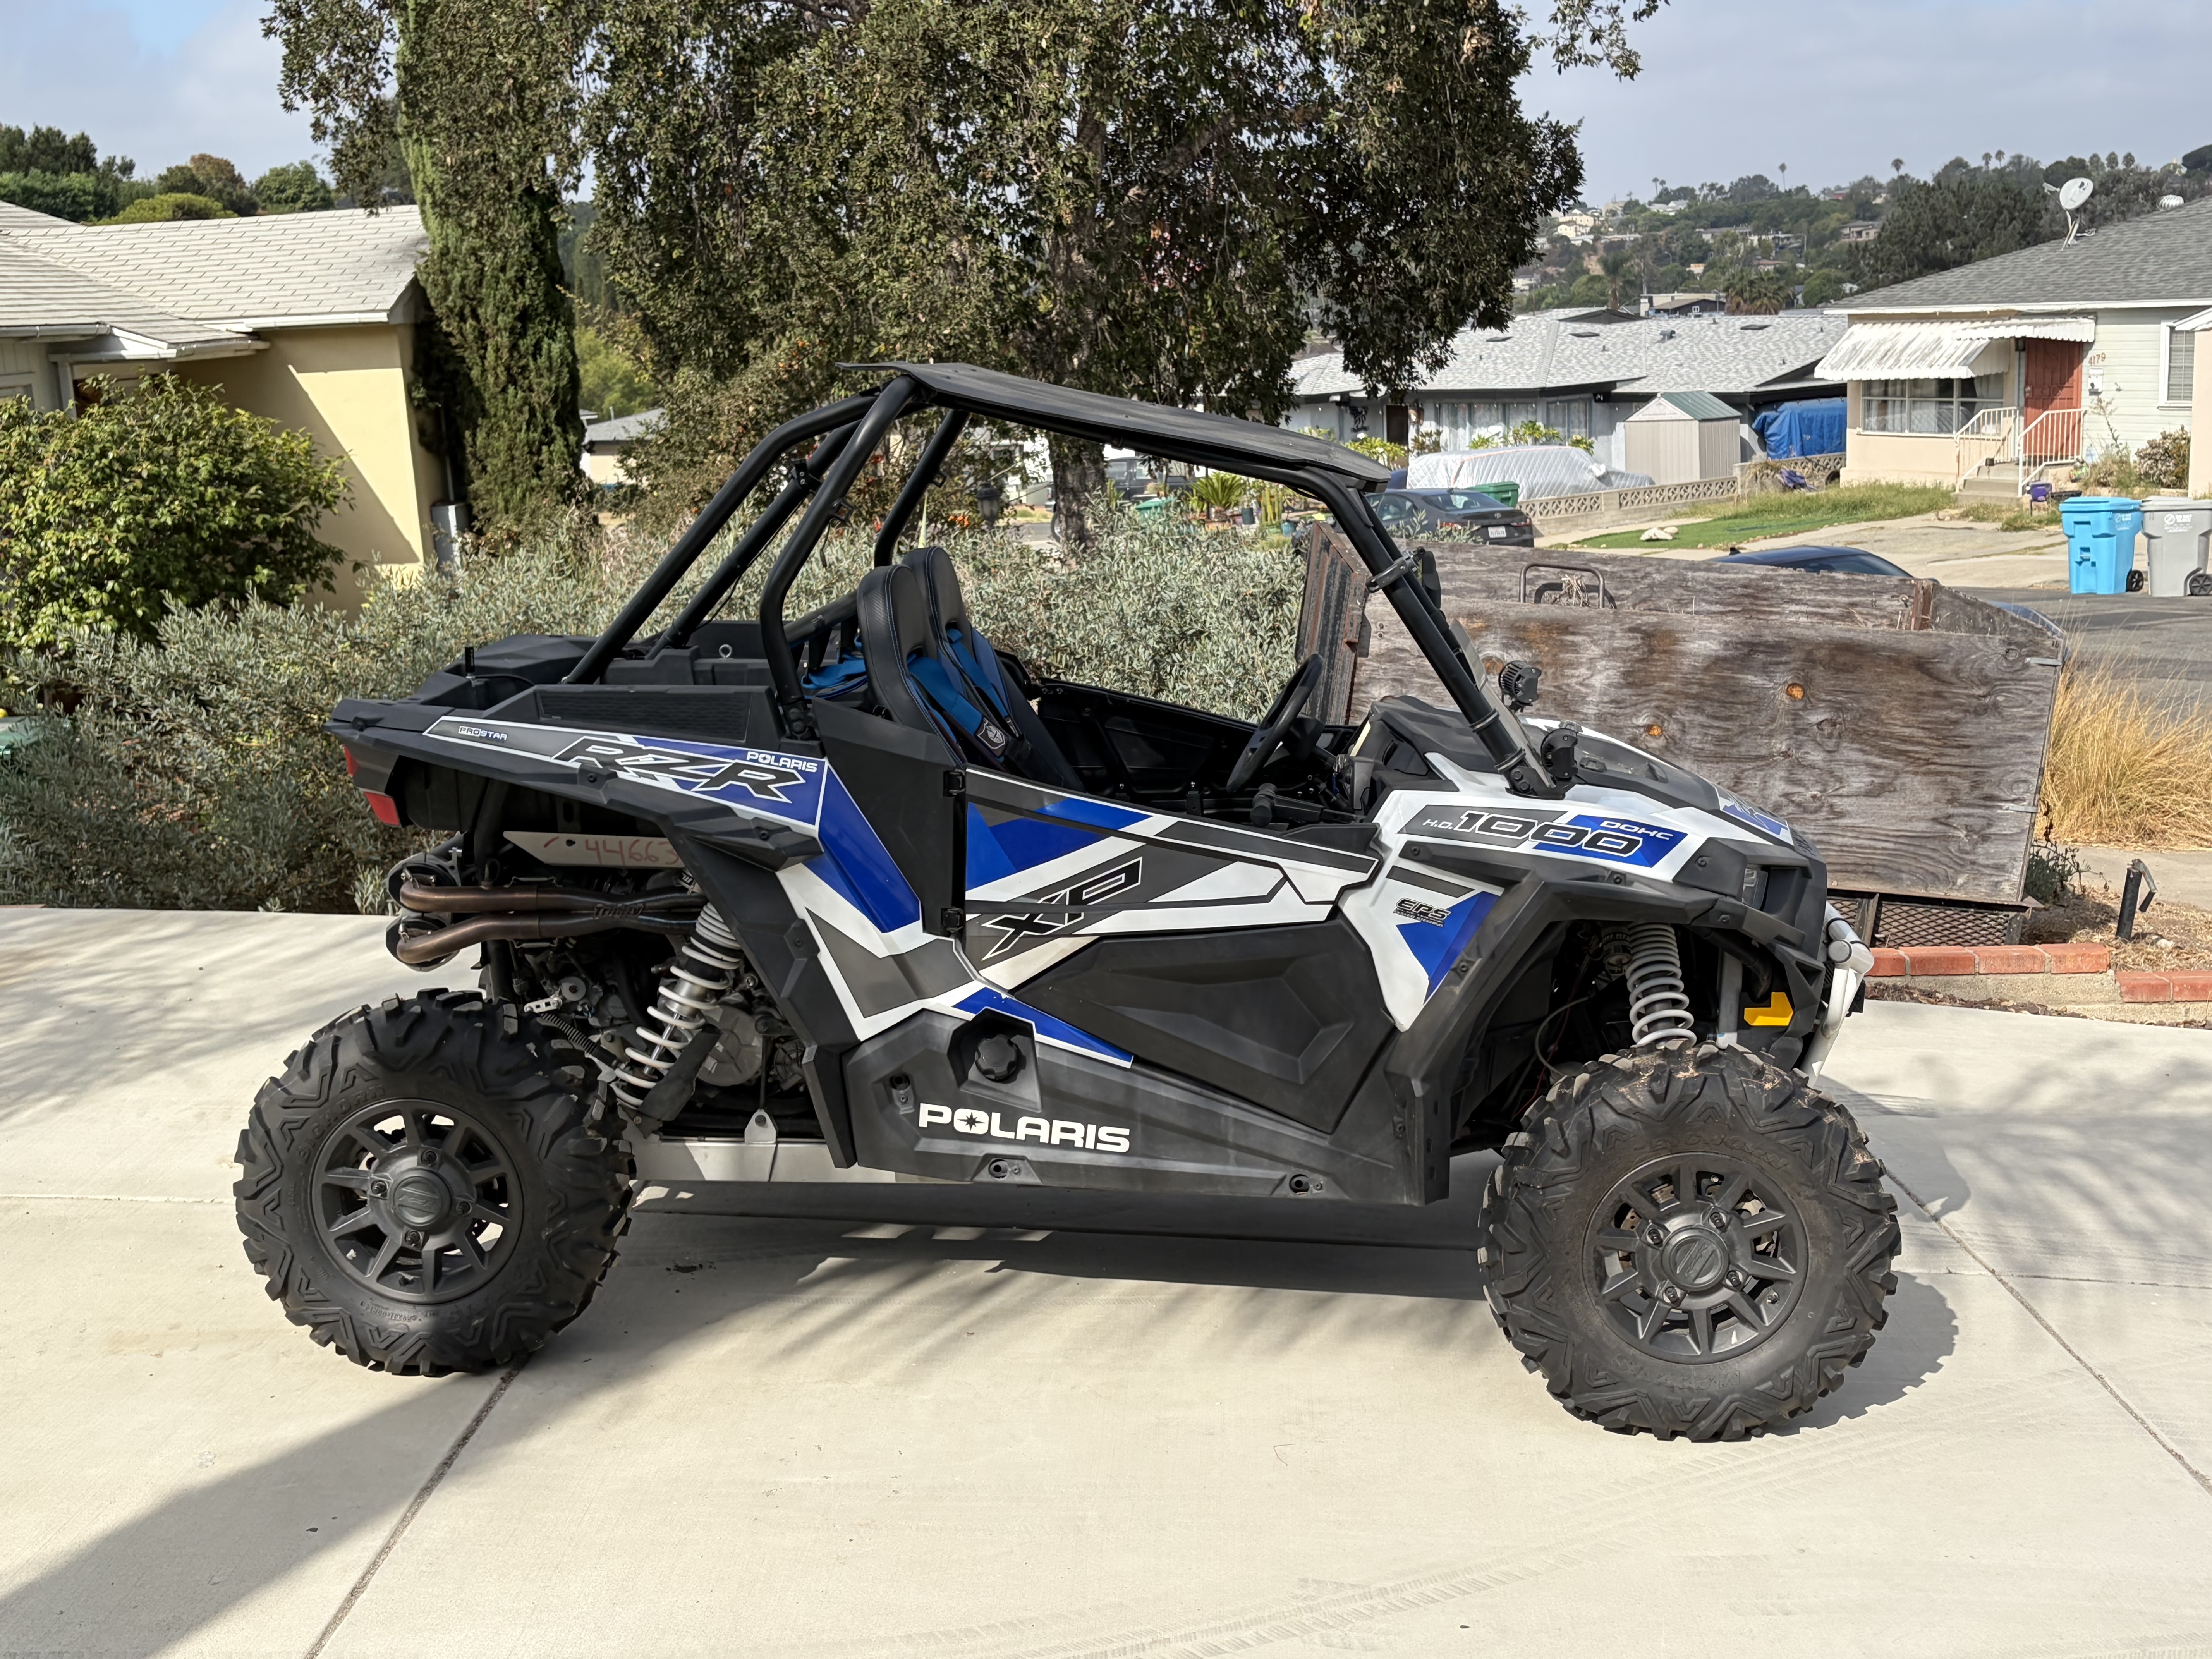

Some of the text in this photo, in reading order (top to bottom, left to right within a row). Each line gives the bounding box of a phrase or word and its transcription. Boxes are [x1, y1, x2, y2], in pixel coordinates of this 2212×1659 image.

[2088, 352, 2106, 366] 4179
[458, 726, 508, 741] PROSTAR
[551, 736, 806, 804] RZR
[746, 751, 818, 773] POLARIS
[1422, 810, 1674, 857] H.O. 1000 DOHC
[981, 856, 1143, 961] XP
[1396, 898, 1452, 920] EPS
[918, 1103, 1130, 1153] POLARIS
